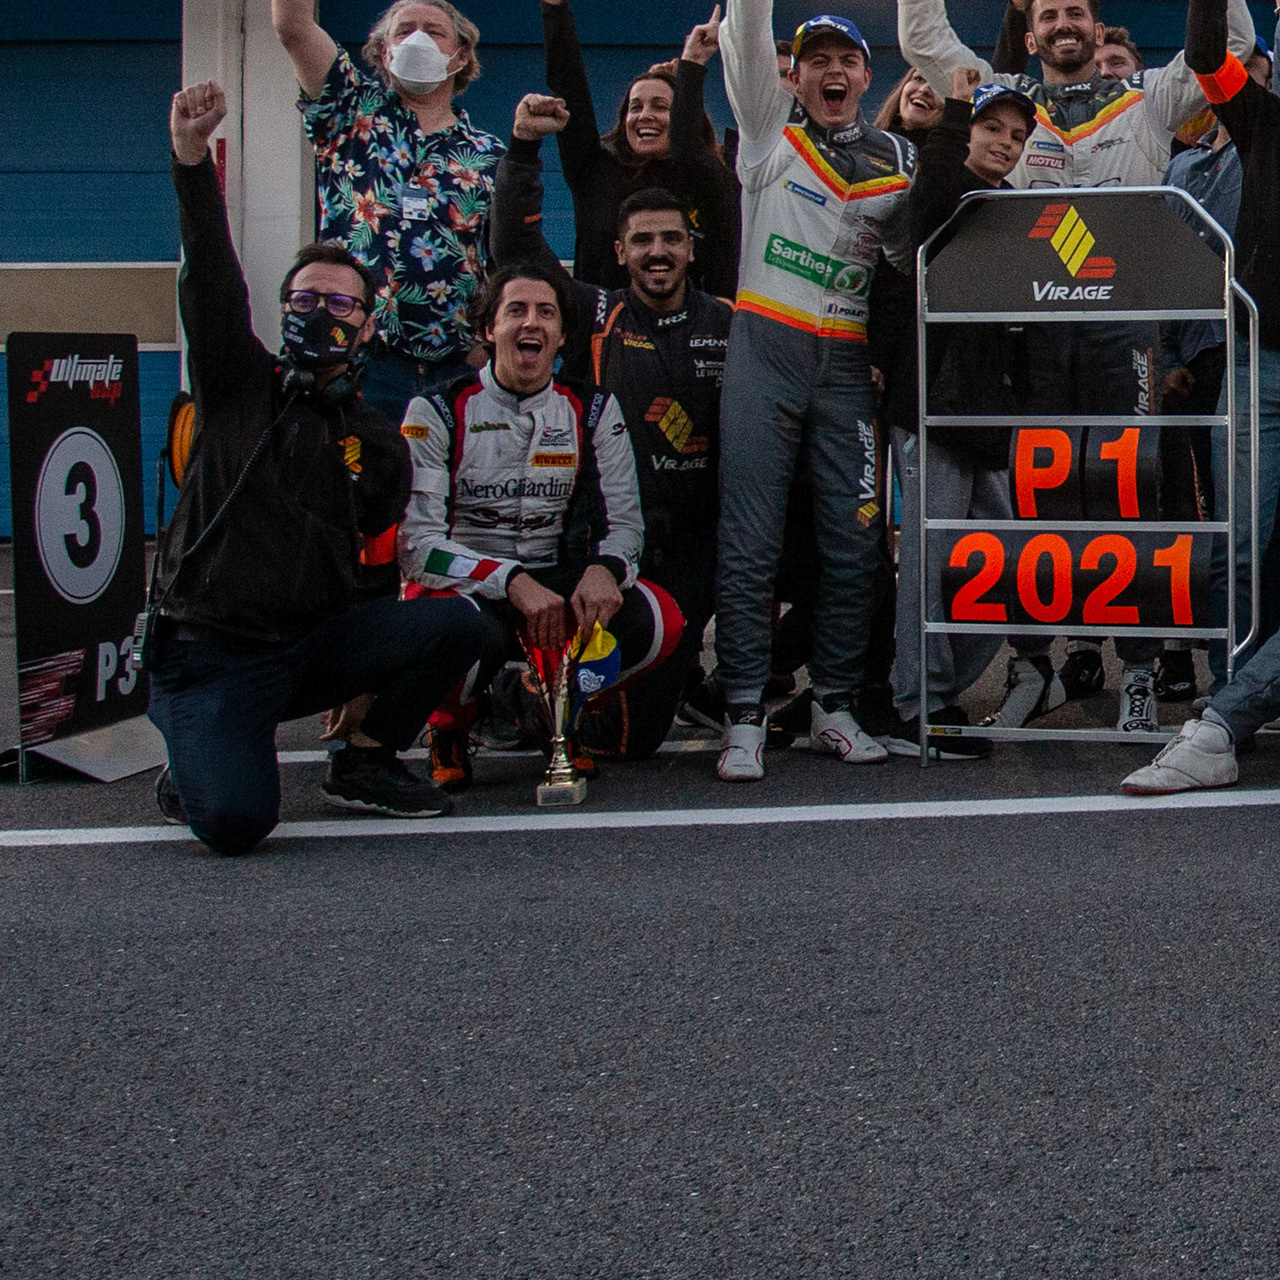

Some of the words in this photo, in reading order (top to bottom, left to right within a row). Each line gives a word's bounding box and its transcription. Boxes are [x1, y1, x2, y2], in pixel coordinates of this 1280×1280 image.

[1028, 156, 1065, 168] MOTUL
[769, 238, 829, 275] Sarthe
[595, 288, 608, 325] HRX
[1032, 280, 1114, 301] VIRAGE
[657, 311, 689, 327] HRX
[651, 453, 709, 471] VIRAGE
[858, 422, 876, 502] VIRAGE
[63, 460, 102, 570] 3
[949, 532, 1194, 626] 2021
[95, 635, 138, 702] P3
